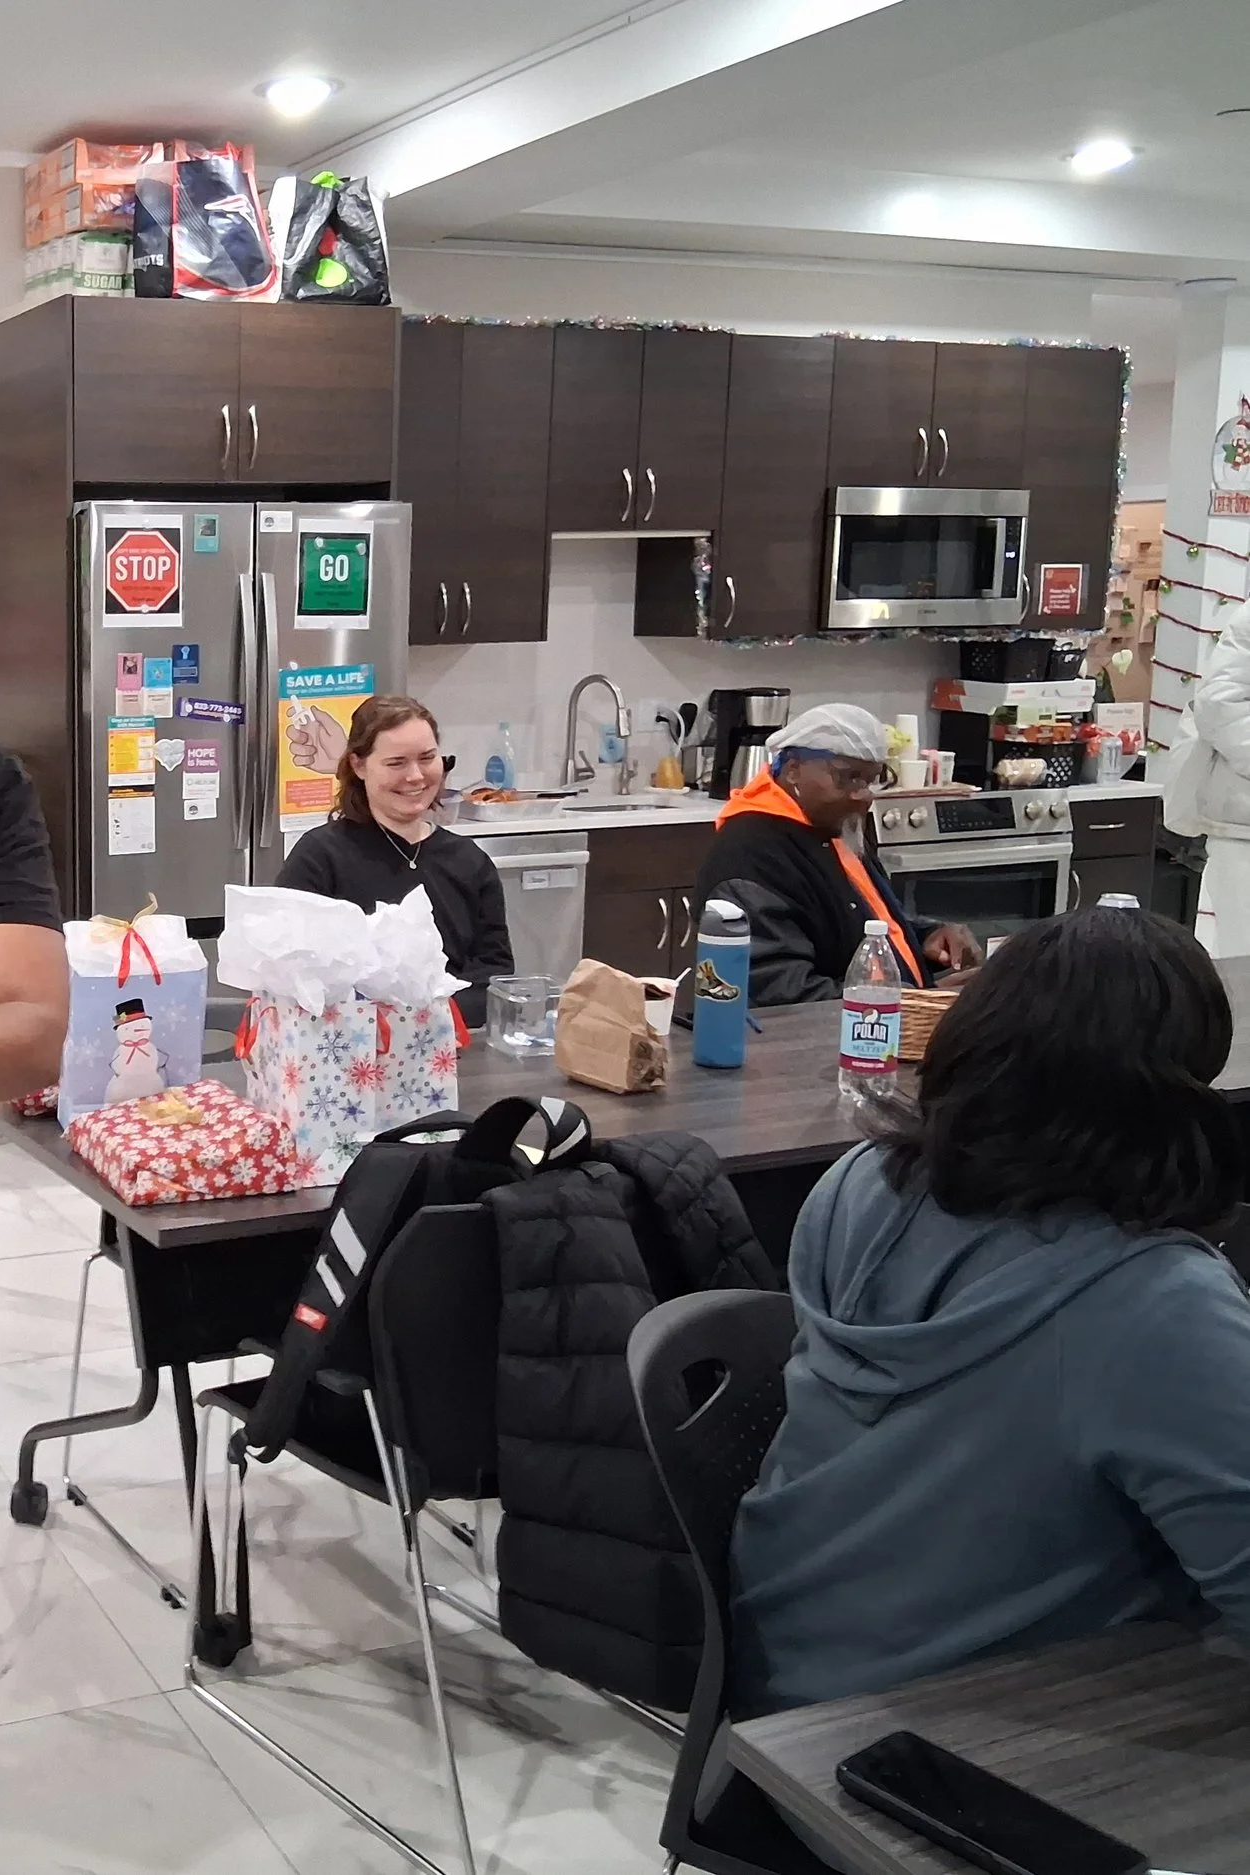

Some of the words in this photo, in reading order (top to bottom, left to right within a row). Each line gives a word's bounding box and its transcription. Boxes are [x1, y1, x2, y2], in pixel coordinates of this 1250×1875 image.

[115, 555, 171, 581] STOP
[319, 554, 349, 582] GO
[286, 674, 323, 687] SAVE
[325, 673, 335, 685] A
[337, 671, 365, 684] LIFE
[187, 747, 216, 758] HOPE
[187, 757, 195, 767] is
[854, 1023, 886, 1041] POLAR
